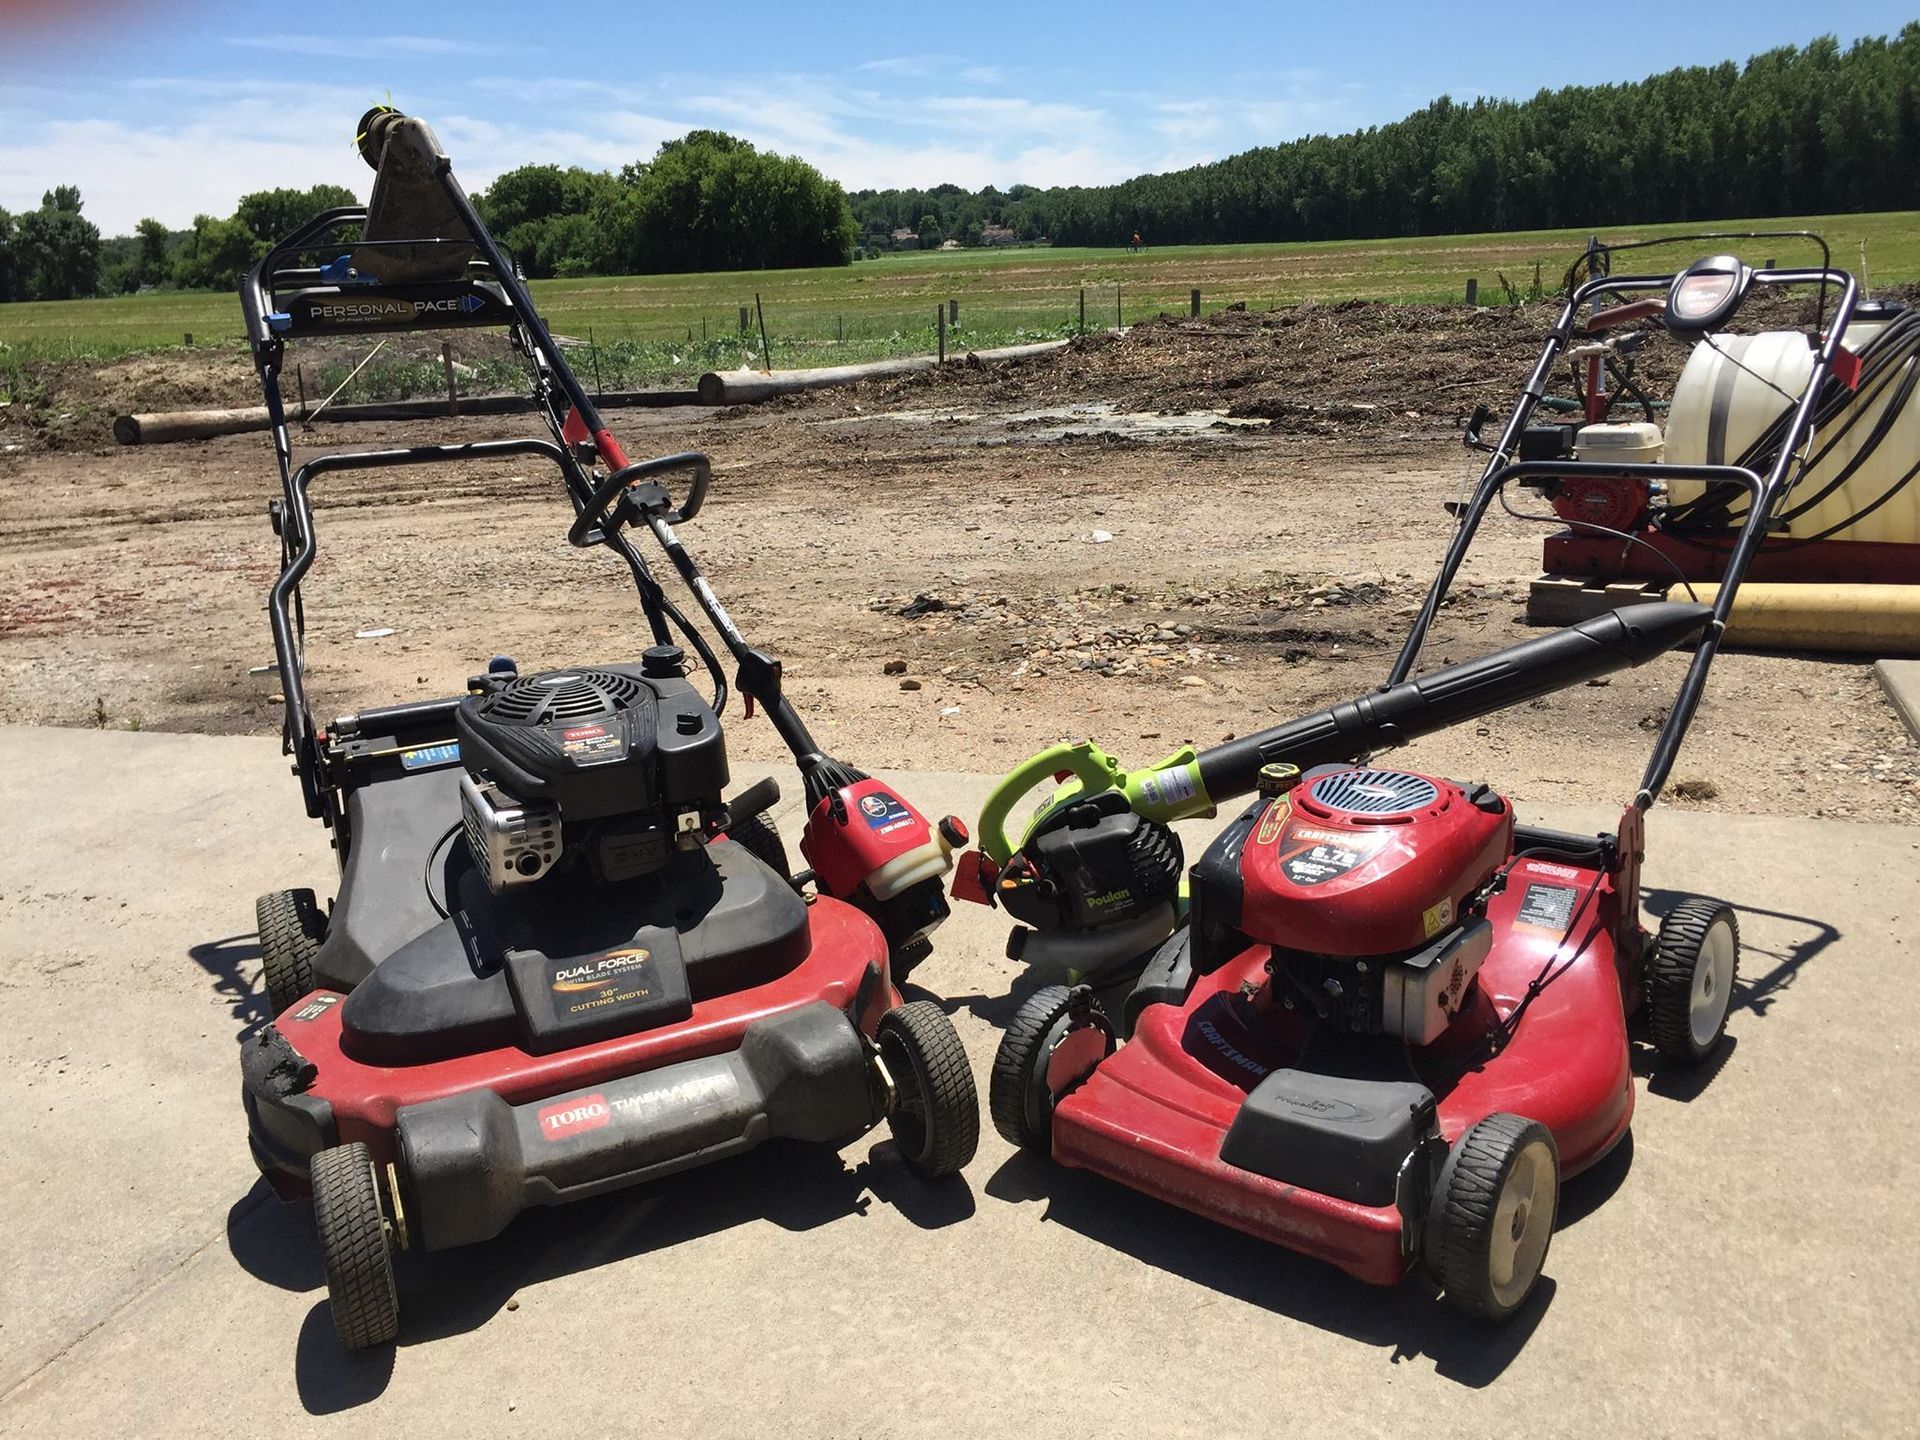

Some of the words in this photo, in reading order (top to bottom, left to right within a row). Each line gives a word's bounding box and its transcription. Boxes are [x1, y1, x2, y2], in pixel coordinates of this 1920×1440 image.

[310, 302, 407, 318] PERSONAL
[413, 299, 458, 313] PACE
[1311, 846, 1357, 867] 6.75
[1087, 889, 1130, 908] Poulan
[556, 965, 595, 981] DUAL
[598, 953, 645, 971] FORCE
[586, 971, 612, 981] BLADE
[613, 964, 642, 975] SYSTEM
[570, 997, 615, 1013] CUTTING
[616, 989, 649, 1001] WIDTH
[600, 988, 619, 998] 30"
[1198, 1020, 1268, 1076] CRAFTSMAN
[545, 1103, 604, 1129] TORO
